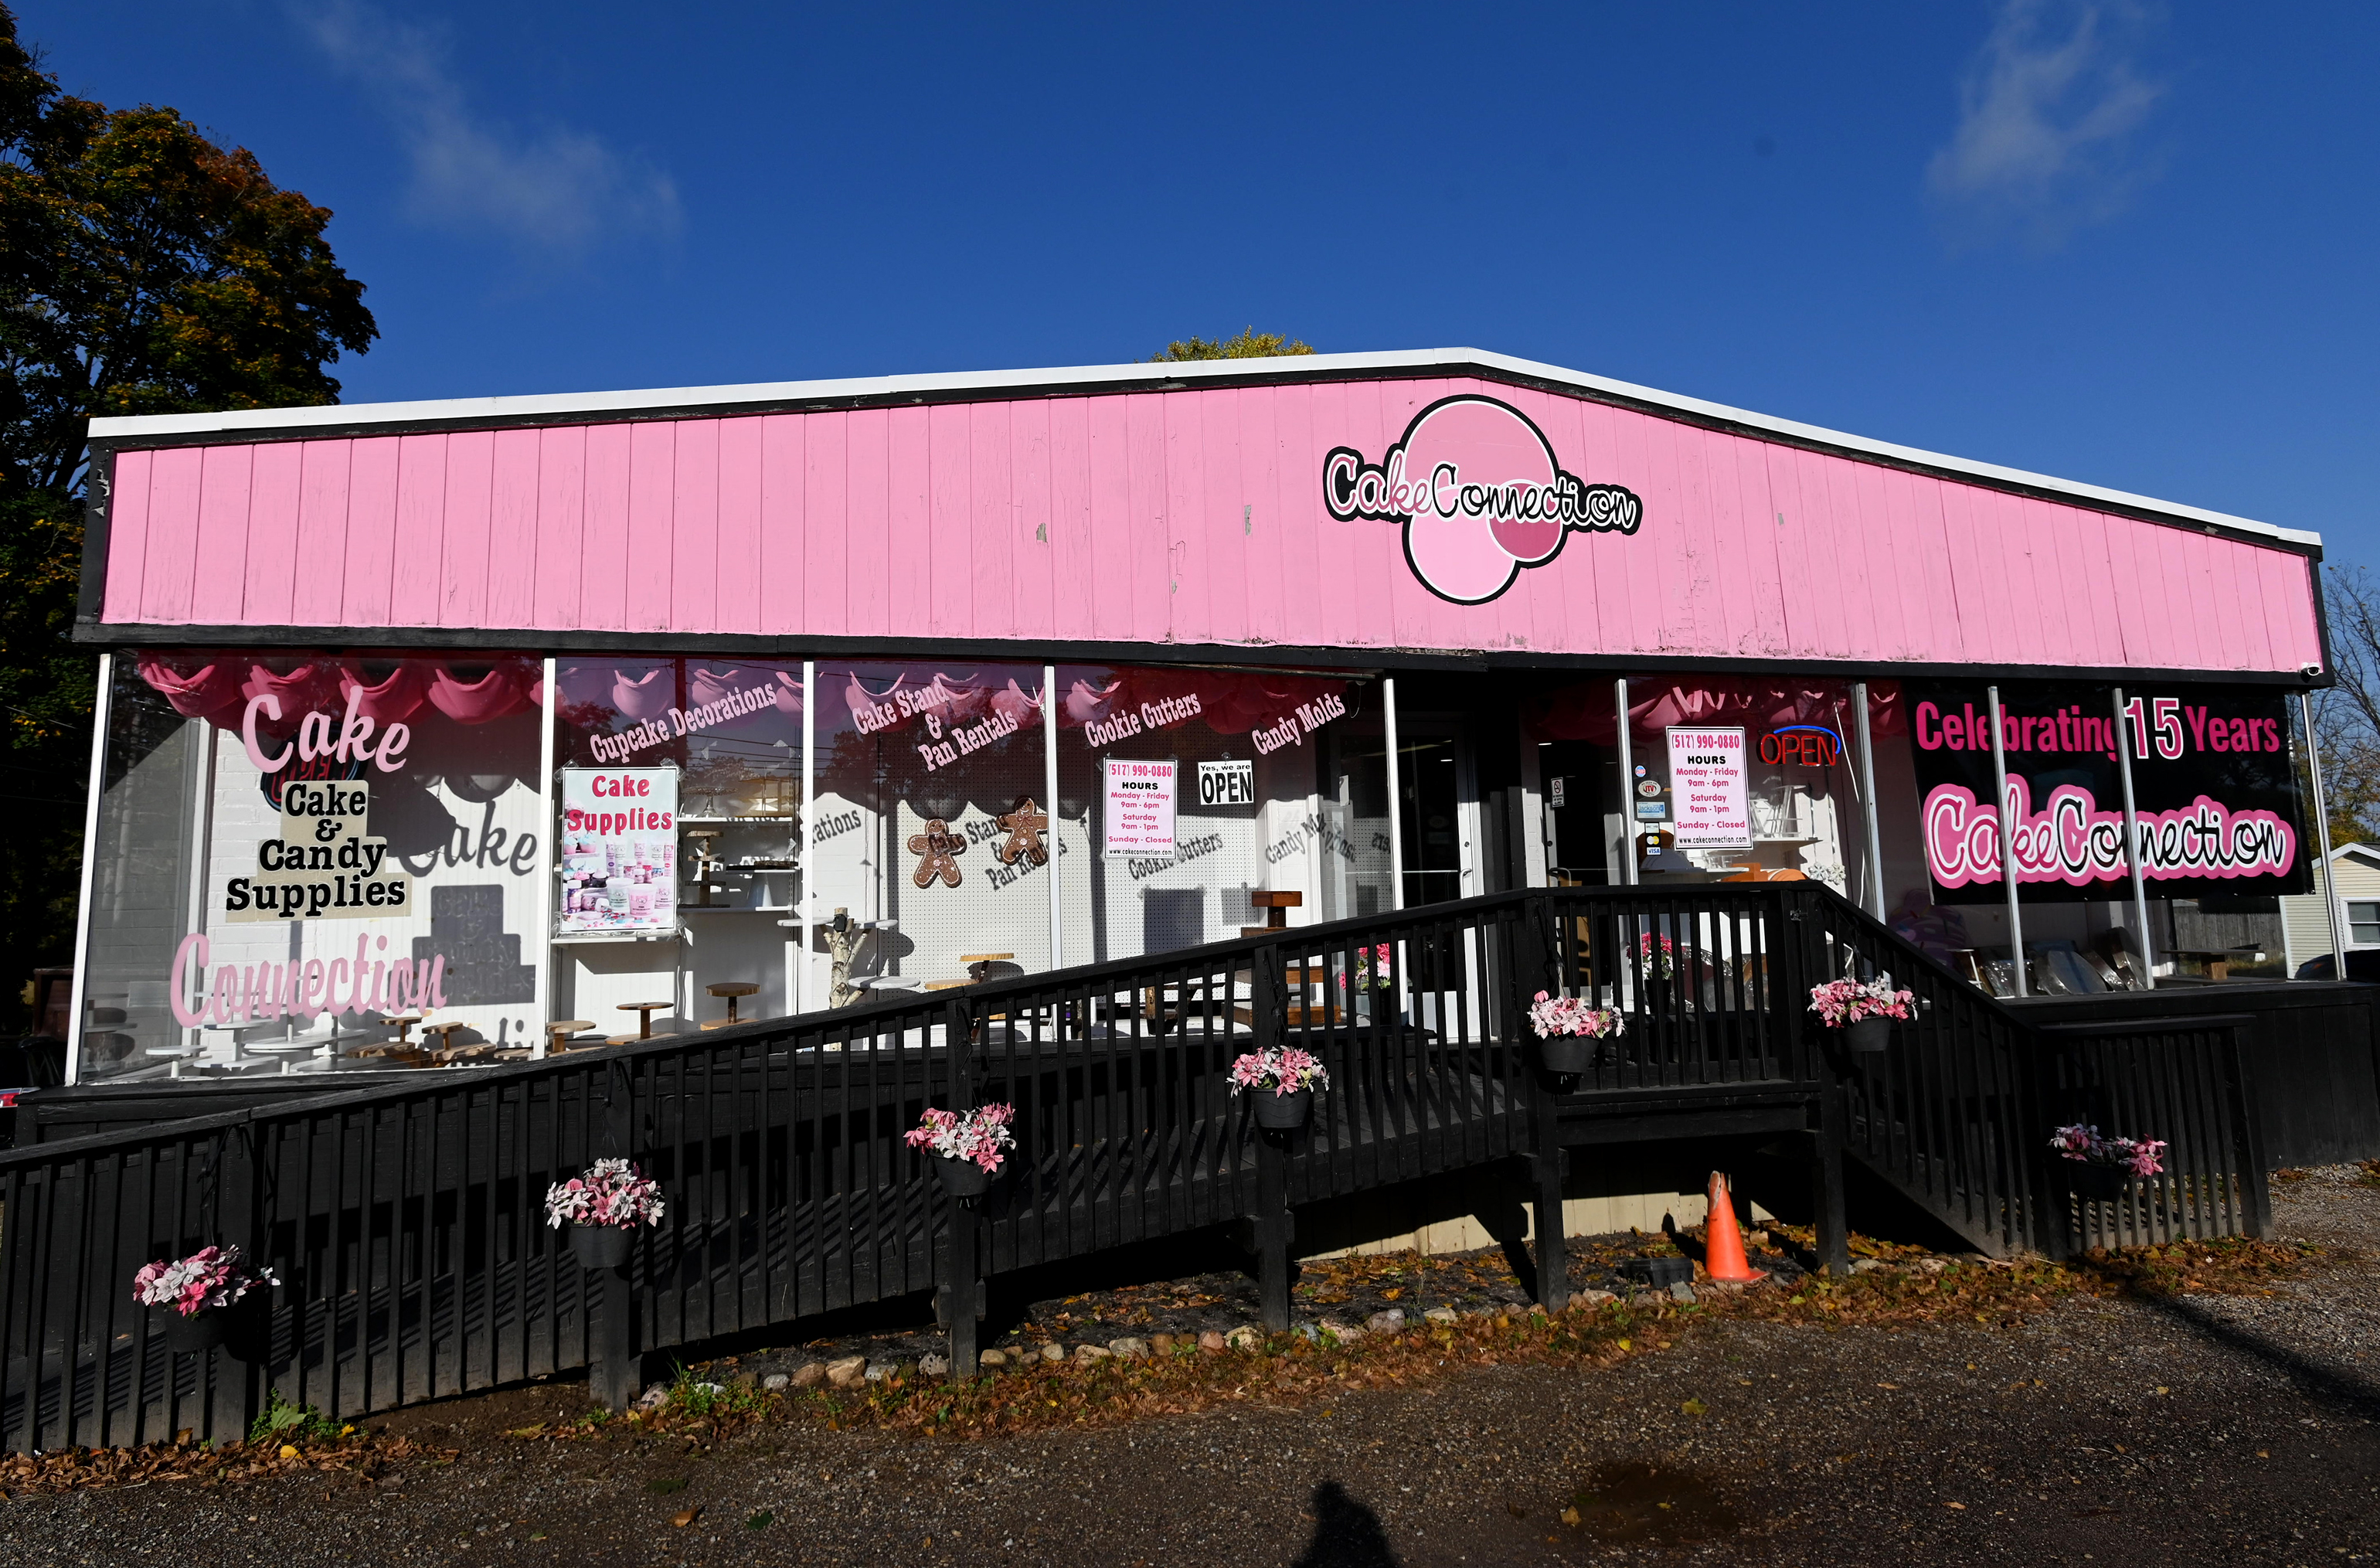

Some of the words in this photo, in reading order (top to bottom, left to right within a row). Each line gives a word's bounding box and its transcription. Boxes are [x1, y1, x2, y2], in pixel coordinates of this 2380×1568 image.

[852, 701, 898, 735] Cake
[895, 675, 950, 719] Stand
[242, 685, 410, 773] Cake
[590, 717, 670, 764] Cupcake
[668, 682, 777, 736] Decorations
[925, 713, 941, 740] &
[1084, 709, 1141, 748] Cookie
[1141, 692, 1202, 729] Cutters
[1252, 716, 1302, 756] Candy
[1295, 692, 1346, 733] Molds
[2123, 697, 2184, 760] 15
[2184, 705, 2280, 753] Years
[918, 741, 957, 772] Pan
[951, 709, 1018, 755] Rentals
[1671, 734, 1695, 749] (517)
[1697, 734, 1740, 749] 990-0880
[1760, 733, 1836, 767] OPEN
[1108, 764, 1130, 776] (517)
[1132, 764, 1172, 777] 990-0880
[1688, 755, 1726, 764] HOURS
[1676, 768, 1708, 777] Monday
[1714, 767, 1739, 777] Friday
[1712, 779, 1729, 788] 6pm
[592, 775, 650, 798] Cake
[1110, 791, 1141, 800] Monday
[1147, 792, 1169, 801] Friday
[1122, 782, 1159, 791] HOURS
[1202, 771, 1253, 804] OPEN
[285, 783, 366, 817] Cake
[1144, 801, 1160, 810] 6pm
[1691, 794, 1727, 803] Saturday
[1713, 805, 1729, 815] 1pm
[315, 818, 342, 842] &
[567, 808, 672, 836] Supplies
[1122, 814, 1157, 823] Saturday
[1677, 821, 1709, 831] Sunday
[1108, 835, 1139, 844] Sunday
[1679, 835, 1747, 845] www.cakeconnection.com
[259, 837, 387, 878] Candy
[1109, 848, 1173, 856] www.cakeconnection.com
[226, 875, 406, 918] Supplies
[169, 932, 447, 1028] Connection
